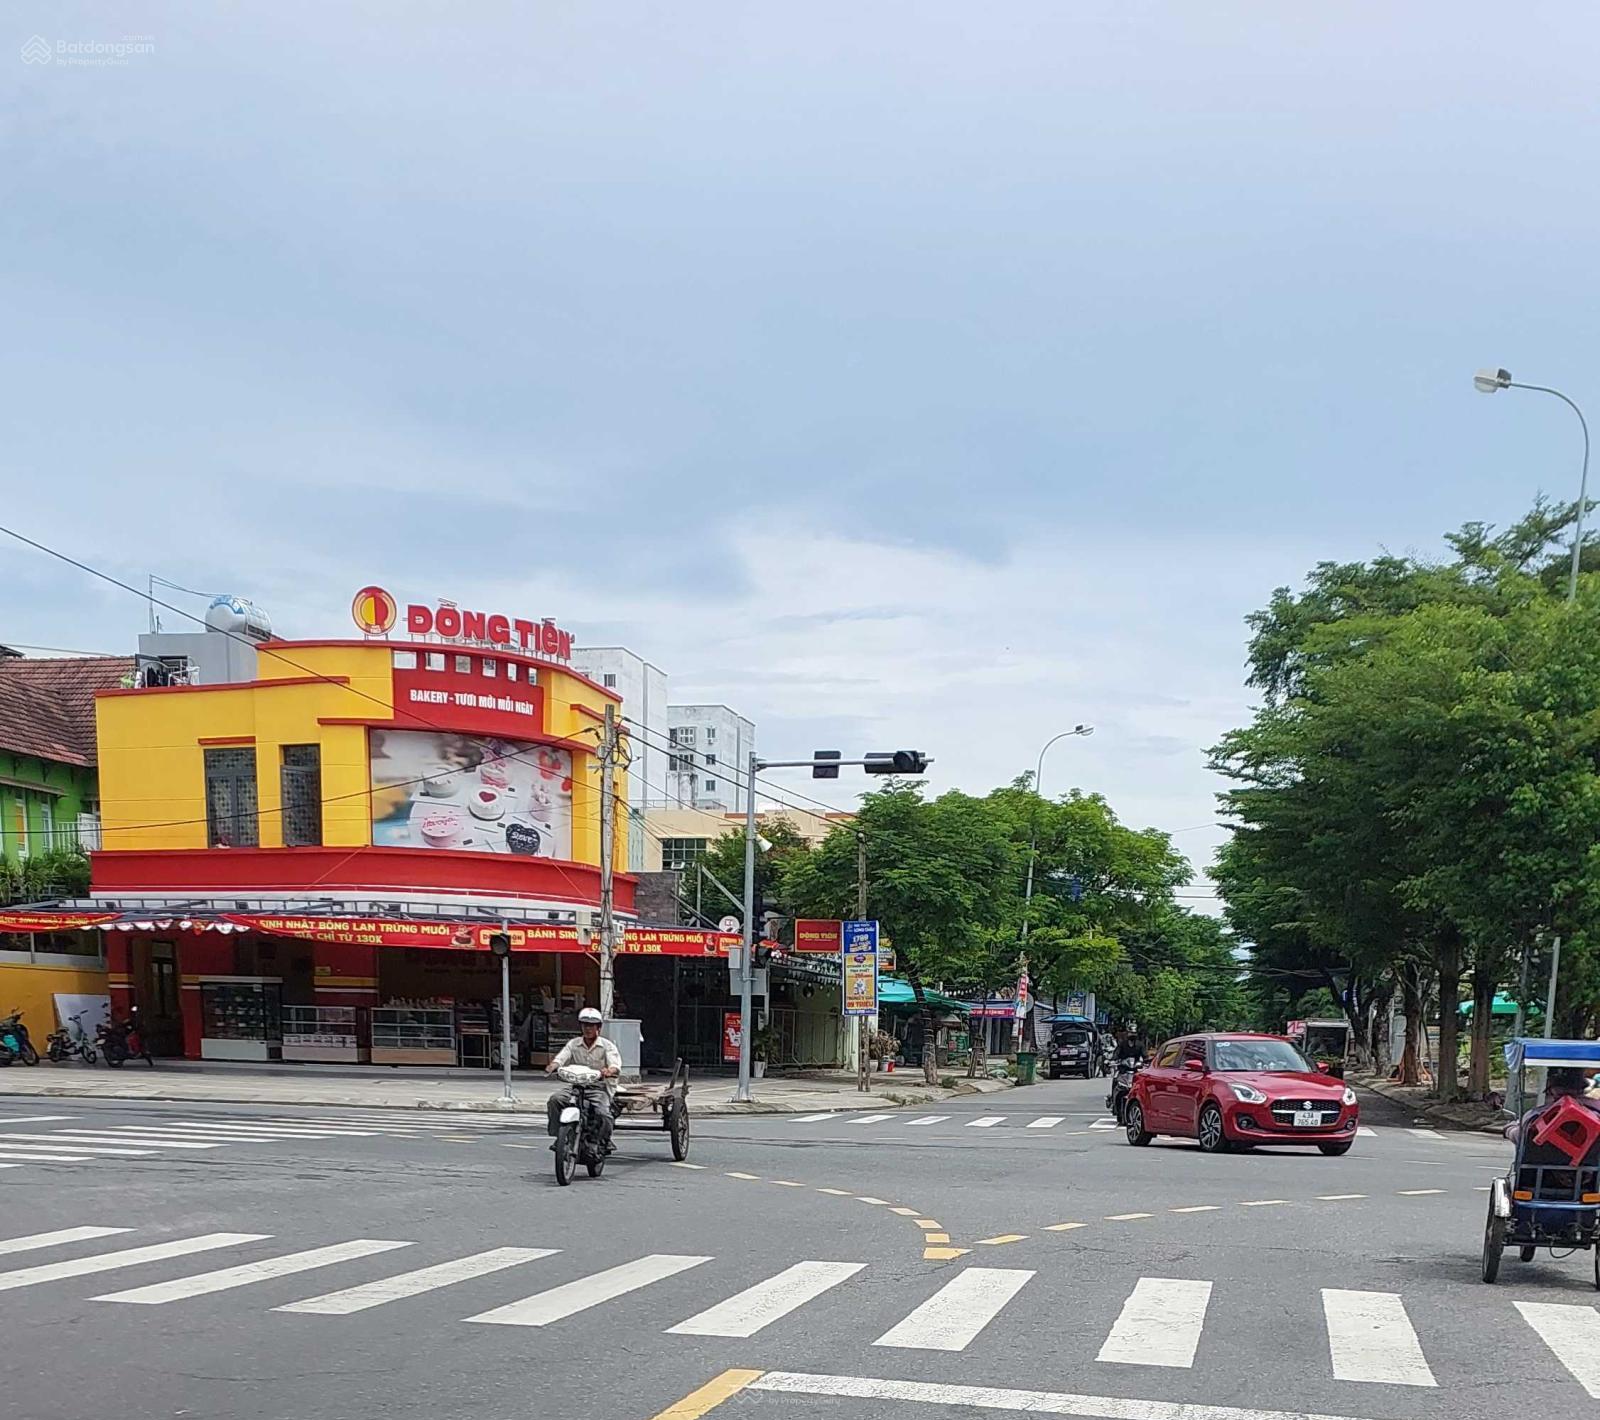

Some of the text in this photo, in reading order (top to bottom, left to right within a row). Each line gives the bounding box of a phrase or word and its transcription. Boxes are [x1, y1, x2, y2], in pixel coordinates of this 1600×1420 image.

[403, 598, 511, 644] ĐỒNG
[410, 689, 448, 704] BAKERY
[319, 919, 350, 931] BÔNG
[352, 922, 377, 932] LAN
[357, 934, 383, 944] 130K
[527, 928, 557, 939] BÁNH
[640, 932, 657, 942] LAN
[642, 944, 662, 953] 130K
